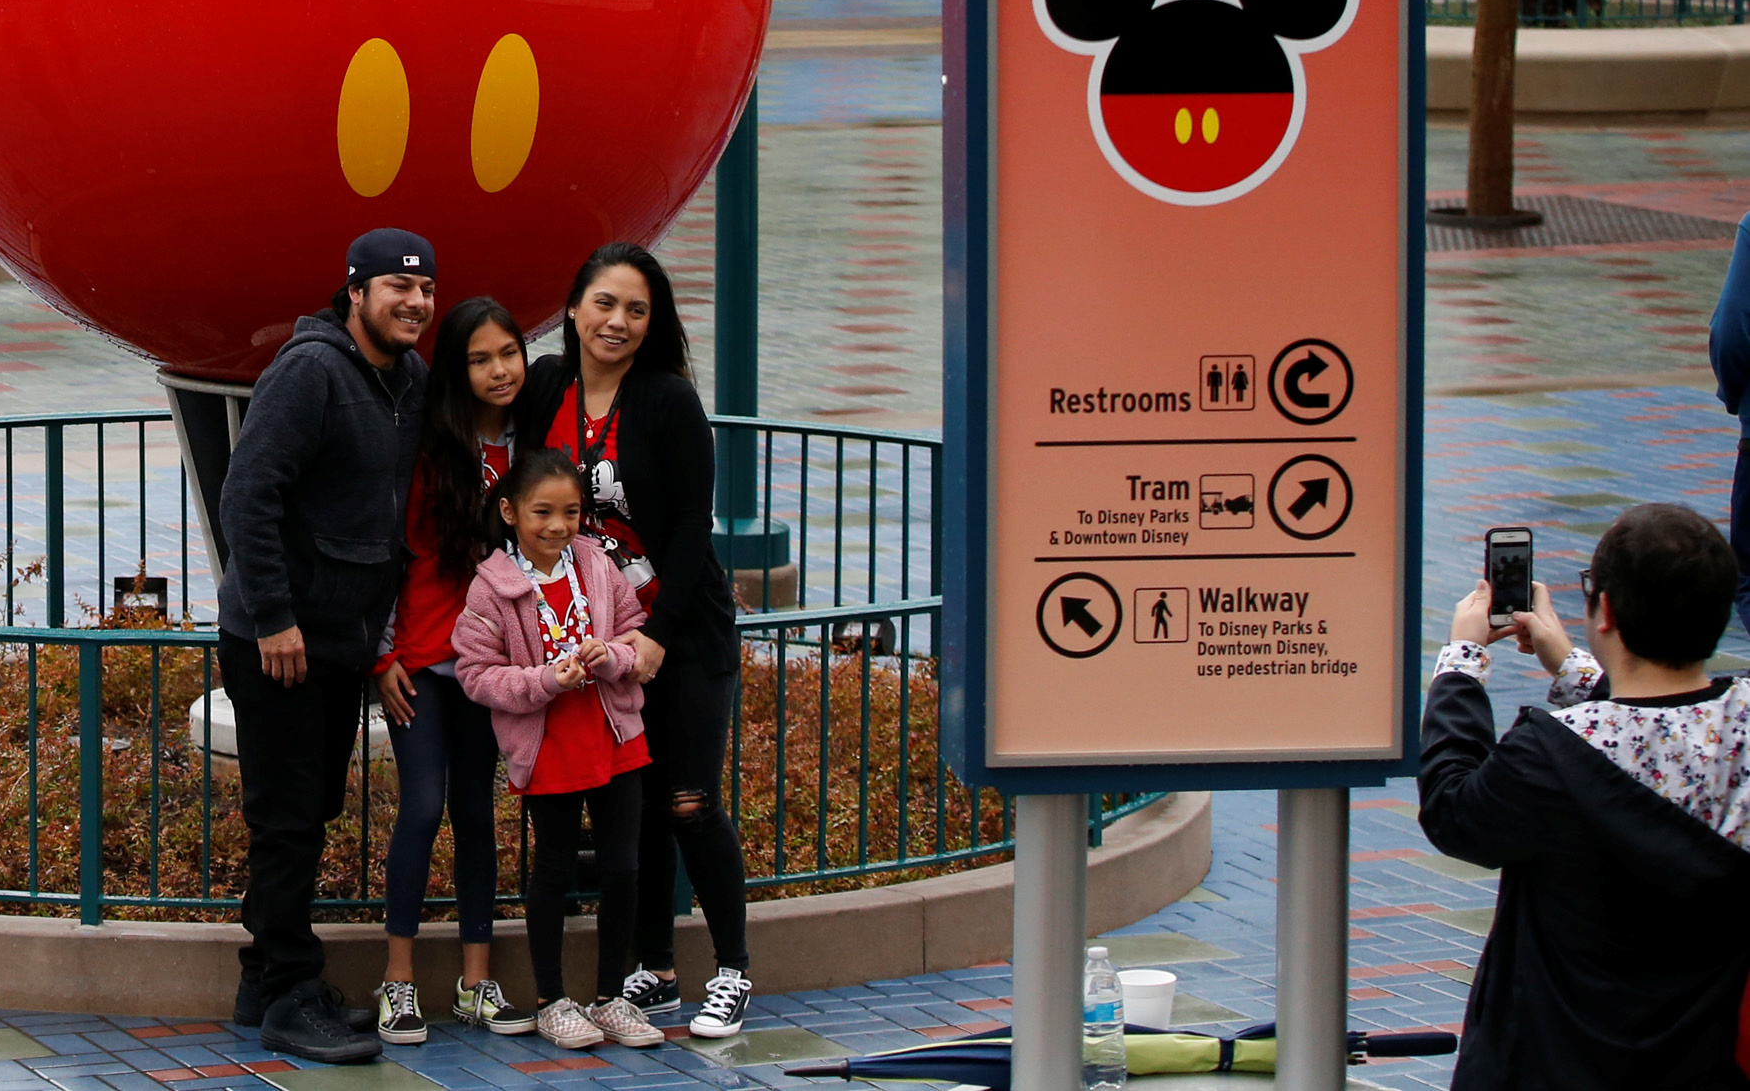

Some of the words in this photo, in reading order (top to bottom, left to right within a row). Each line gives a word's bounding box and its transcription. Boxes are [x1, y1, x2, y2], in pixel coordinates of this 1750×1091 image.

[1049, 386, 1192, 415] Restrooms
[1125, 474, 1190, 502] Tram
[1077, 509, 1093, 525] To
[1097, 508, 1145, 528] Disney
[1149, 508, 1190, 524] Parks
[1049, 530, 1060, 546] &
[1064, 529, 1137, 546] Downtown
[1141, 528, 1190, 547] Disney
[1198, 586, 1310, 619] Walkway
[1197, 621, 1214, 637] To
[1218, 621, 1267, 640] Disney
[1272, 620, 1313, 636] Parks
[1317, 619, 1328, 635] &
[1197, 640, 1272, 656] Downtown
[1276, 639, 1329, 658] Disney,
[1196, 664, 1223, 677] use
[1227, 660, 1307, 680] pedestrian
[1310, 659, 1358, 678] bridge
